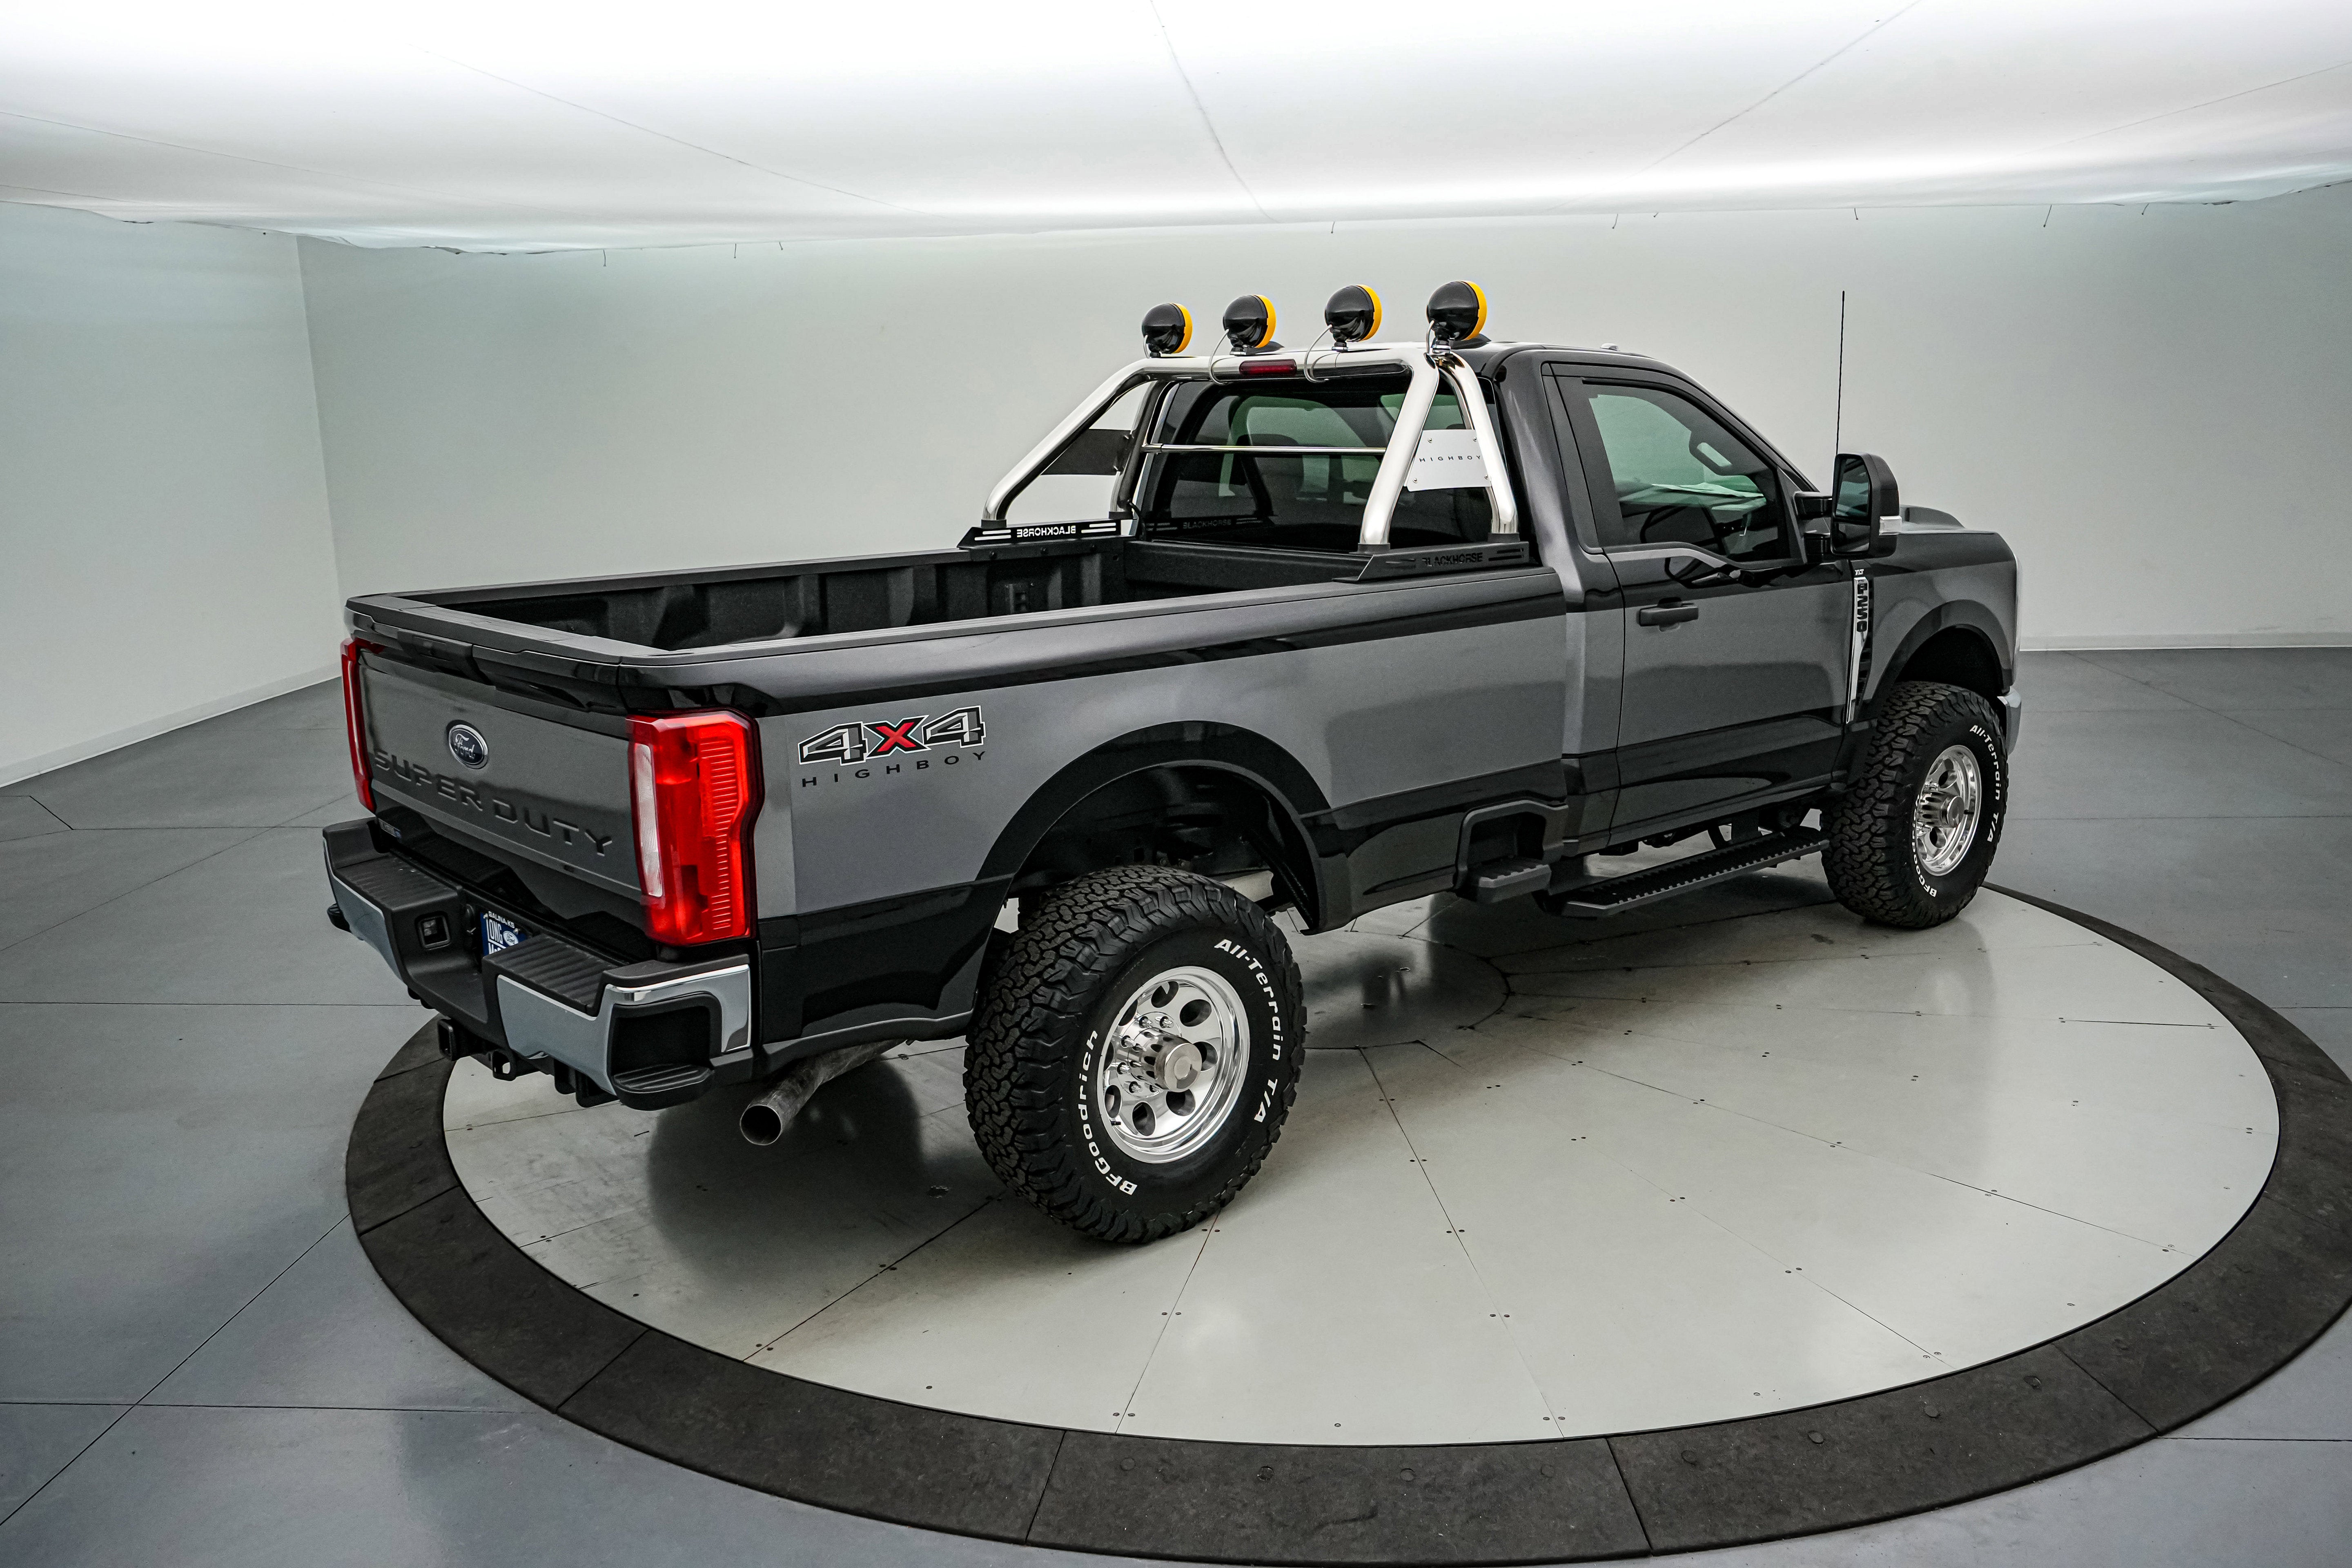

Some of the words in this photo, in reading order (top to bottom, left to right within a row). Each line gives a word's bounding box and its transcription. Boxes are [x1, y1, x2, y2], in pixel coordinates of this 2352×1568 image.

[454, 733, 476, 759] Ford
[802, 751, 986, 787] HIGHBOY
[1969, 725, 2001, 801] All-Terrain
[1987, 812, 1999, 842] T/A
[374, 747, 483, 812] SUPER
[492, 798, 612, 857] DUTY
[1911, 794, 1938, 898] BFGoodrich
[486, 919, 506, 949] LONG
[1214, 939, 1283, 1060] All-Terrain
[1254, 1078, 1279, 1123] T/A
[1078, 1030, 1138, 1196] BFGoodrich
